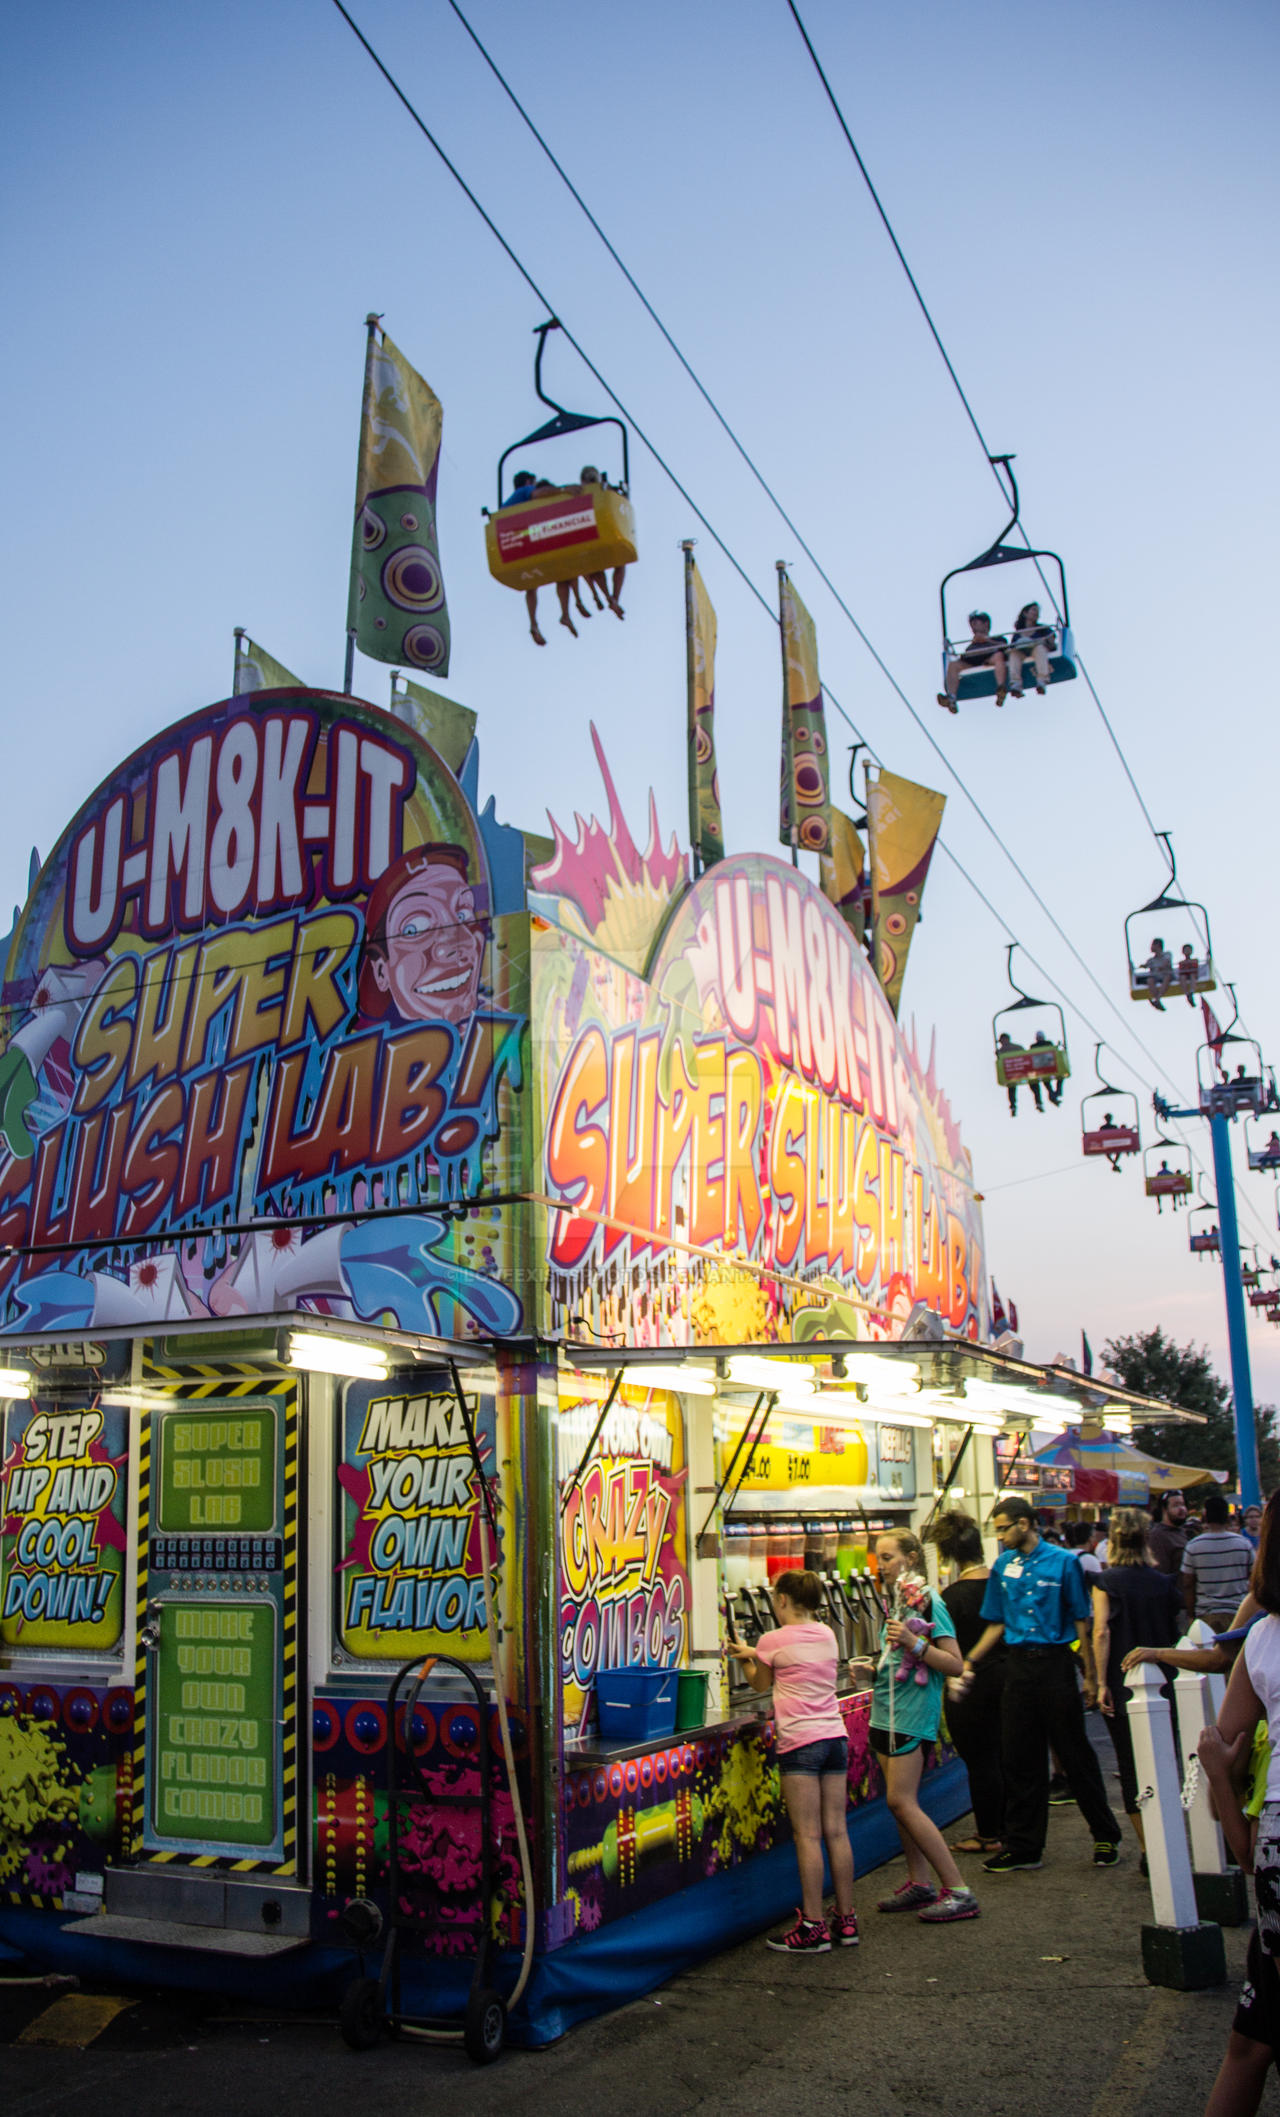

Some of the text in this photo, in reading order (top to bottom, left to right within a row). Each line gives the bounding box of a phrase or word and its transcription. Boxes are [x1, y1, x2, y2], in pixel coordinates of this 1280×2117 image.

[68, 713, 408, 948] U-M8K-IT
[71, 911, 359, 1117] SUPER
[257, 1014, 517, 1194] LAB!
[547, 1023, 765, 1268] SUPER
[769, 1074, 906, 1290] SLUSH
[24, 1411, 102, 1462] STEP
[173, 1421, 261, 1453] SUPER
[359, 1393, 478, 1454] MAKE
[7, 1463, 116, 1515] UP AND
[173, 1457, 261, 1489] SLUSH
[369, 1454, 476, 1511] YOUR
[189, 1494, 243, 1525] LAB
[563, 1463, 671, 1601] CRAZY
[17, 1518, 98, 1568] COOL
[371, 1513, 473, 1570] OWN
[5, 1572, 119, 1623] DOWN!
[348, 1574, 496, 1634] FLAVOR
[175, 1609, 255, 1642] MAKE
[562, 1578, 684, 1690] COMBOS
[177, 1646, 253, 1678] YOUR
[181, 1681, 247, 1713] OWN
[168, 1716, 259, 1750] CRAZY
[161, 1750, 267, 1788] FLAVOR
[163, 1786, 263, 1825] COMBO
